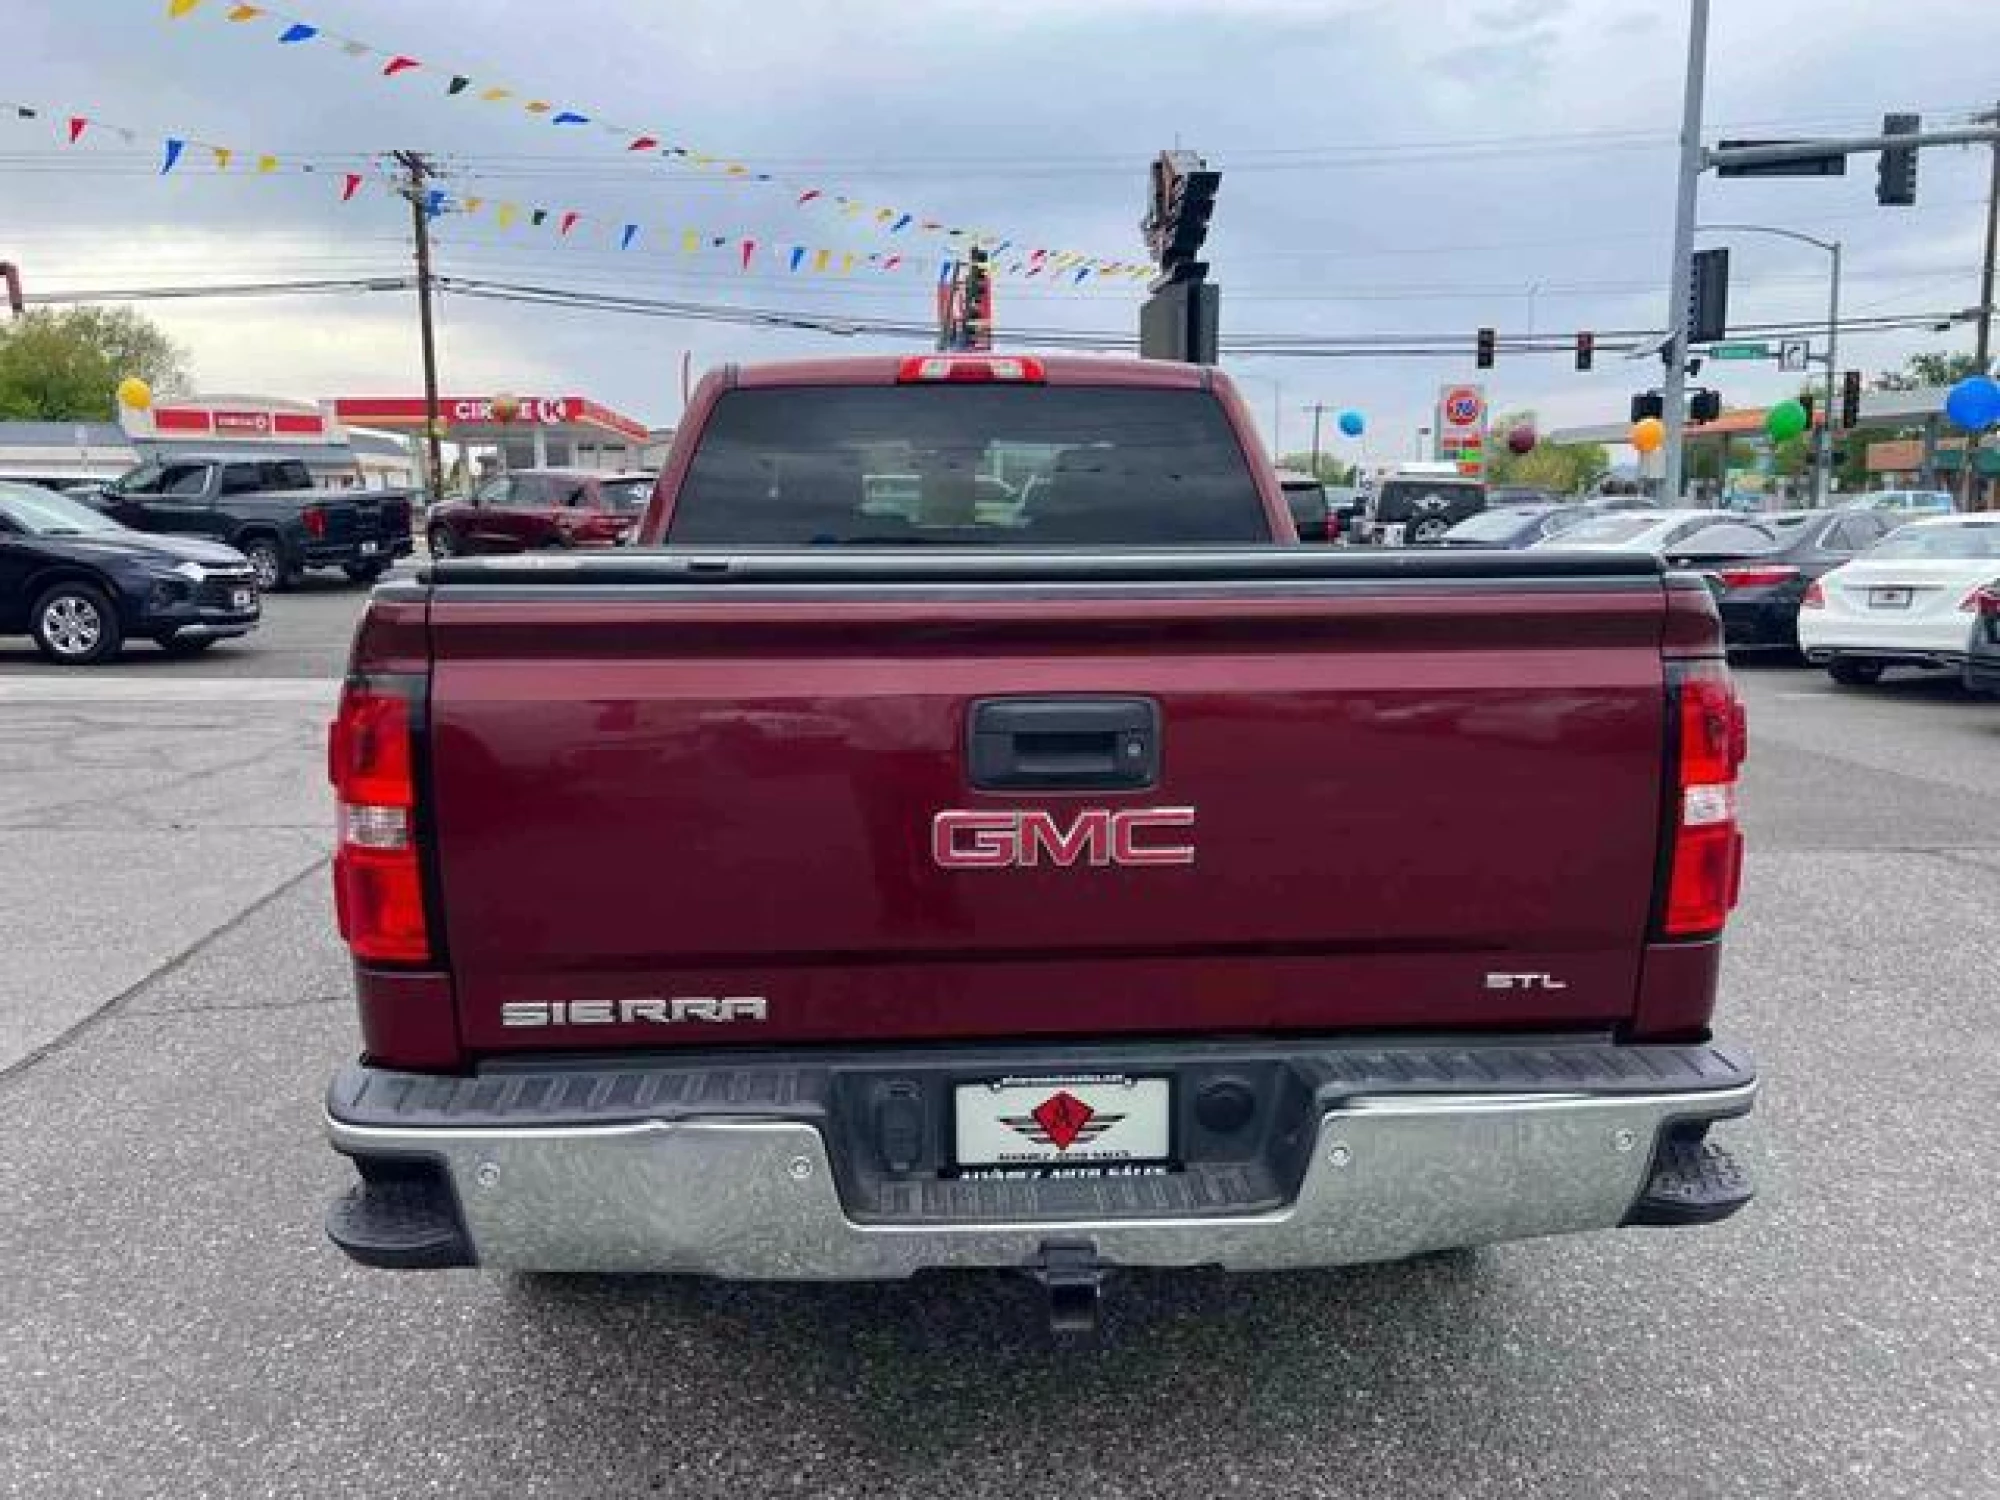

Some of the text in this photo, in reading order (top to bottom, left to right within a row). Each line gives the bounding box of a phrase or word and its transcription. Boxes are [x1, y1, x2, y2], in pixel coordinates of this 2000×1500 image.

[455, 401, 533, 420] CIRE
[932, 806, 1195, 867] GMC
[501, 996, 767, 1027] SIERRA
